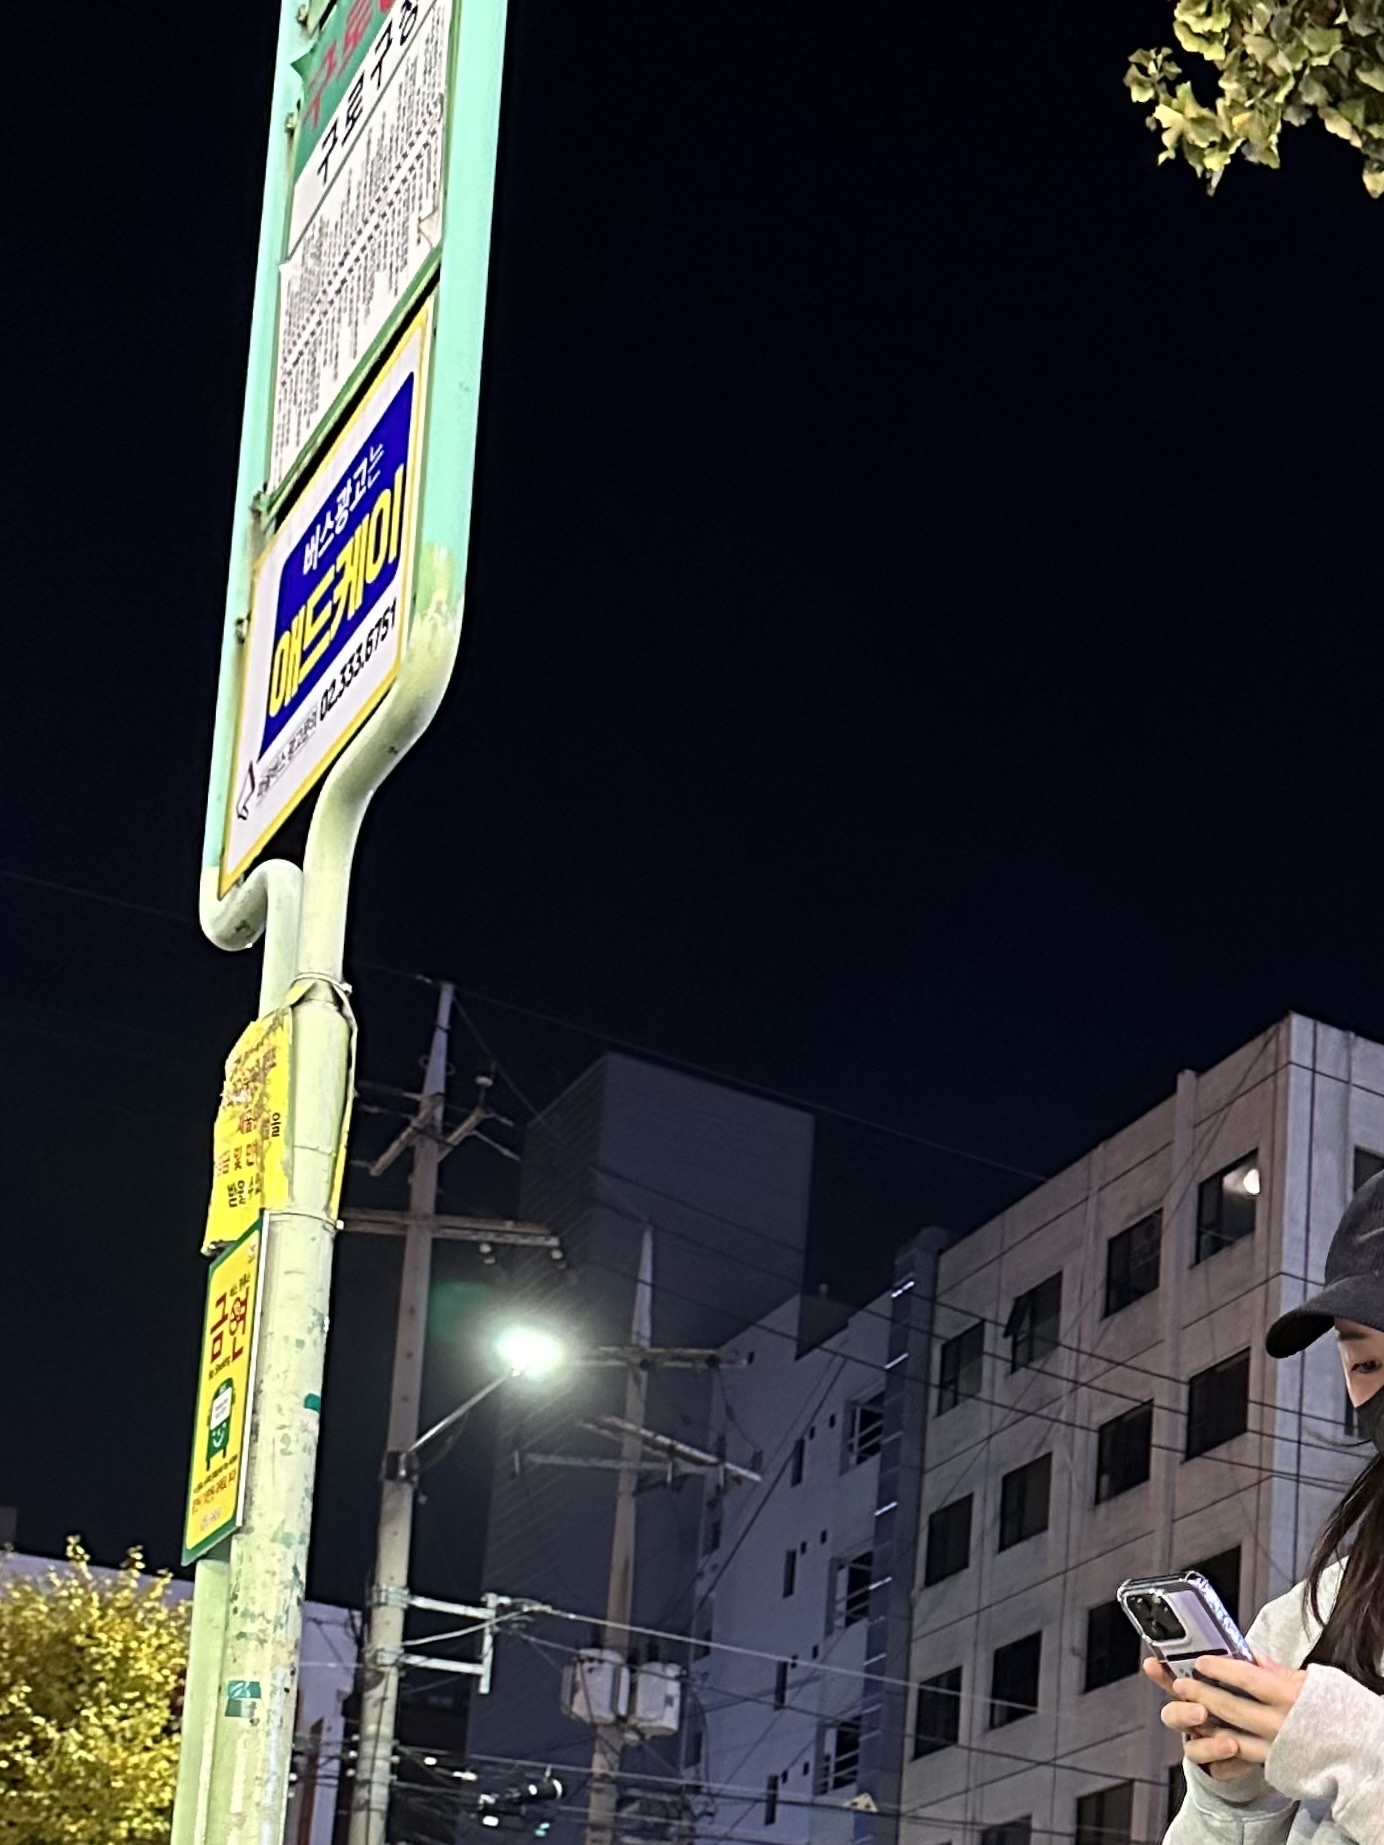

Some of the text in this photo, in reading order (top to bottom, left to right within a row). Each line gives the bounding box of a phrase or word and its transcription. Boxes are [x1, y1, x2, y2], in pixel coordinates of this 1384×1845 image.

[303, 443, 384, 576] 버스광고는
[268, 462, 404, 718] 애드케이
[319, 597, 397, 722] 02.333.6751
[210, 1286, 250, 1362] 금연
